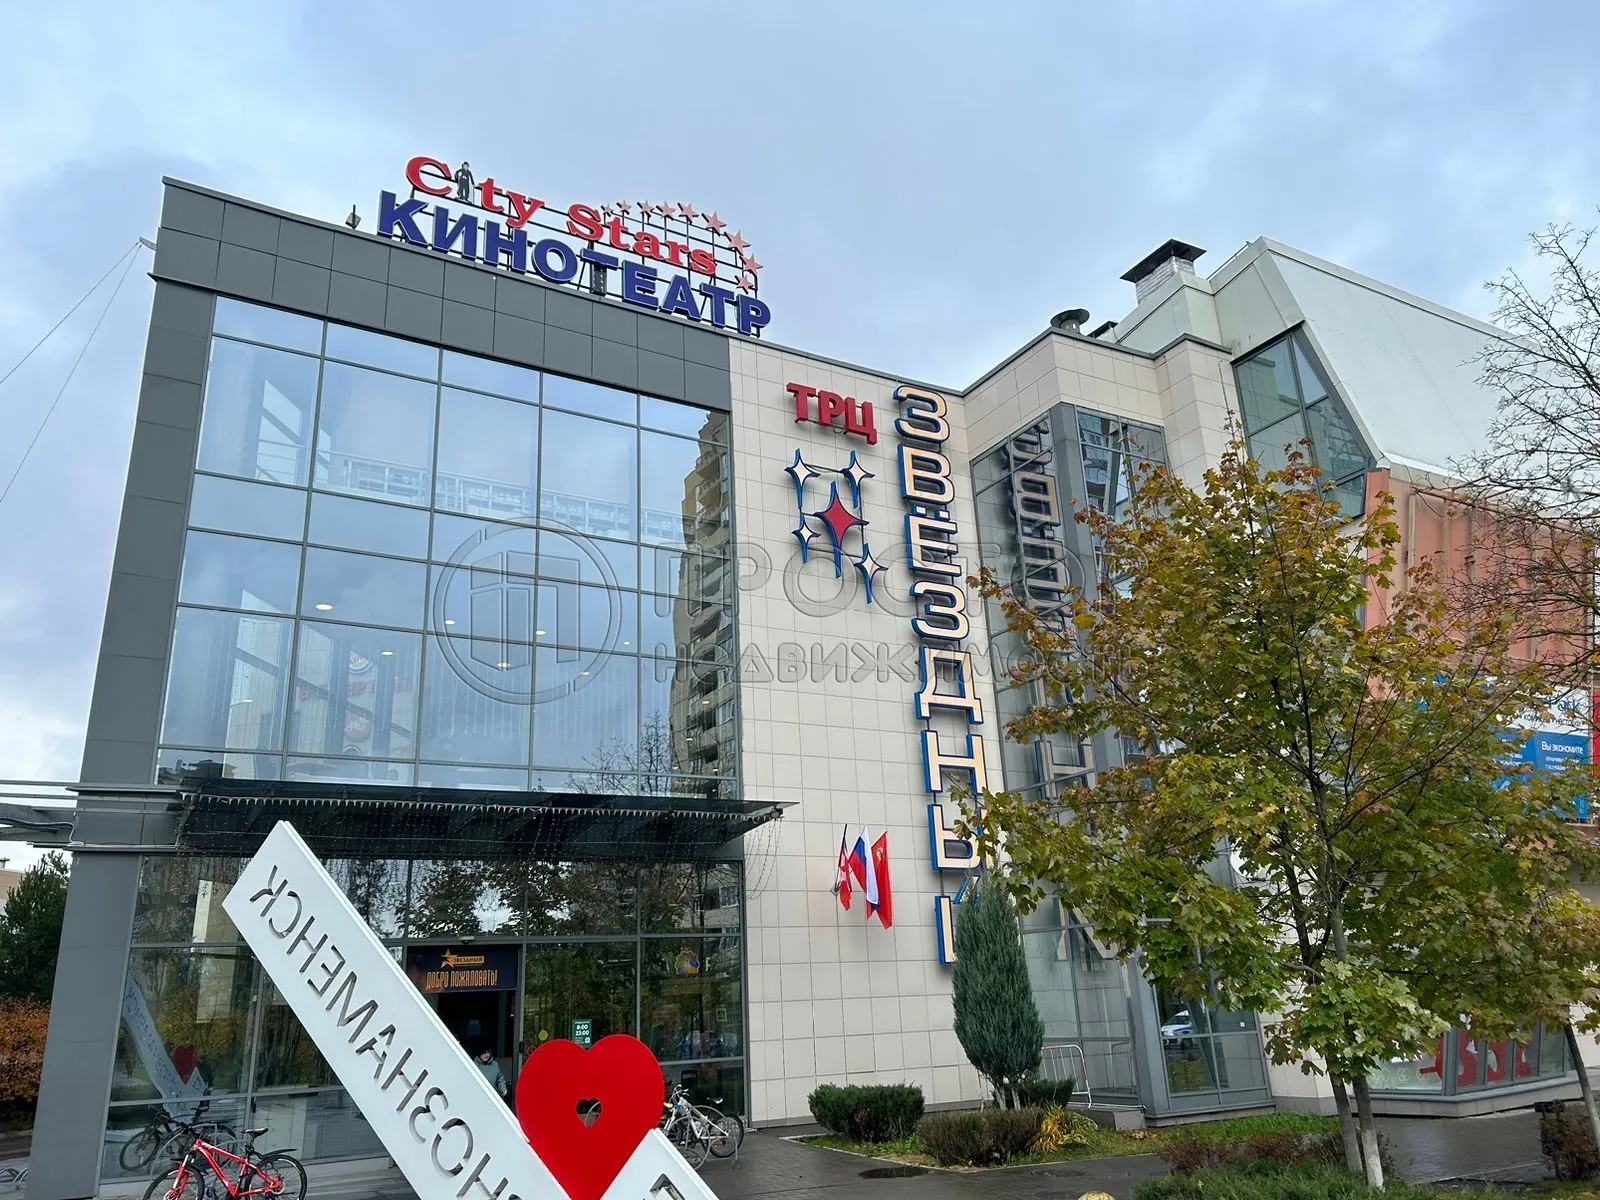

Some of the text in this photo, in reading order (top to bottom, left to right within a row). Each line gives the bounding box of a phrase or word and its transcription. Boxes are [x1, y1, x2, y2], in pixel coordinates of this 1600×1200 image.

[377, 189, 771, 336] КИНОТЕАТР
[566, 202, 718, 276] Stars
[786, 382, 878, 446] ТРЦ
[426, 969, 498, 990] ДОБРО ПОЖАЛОВАТЬ!
